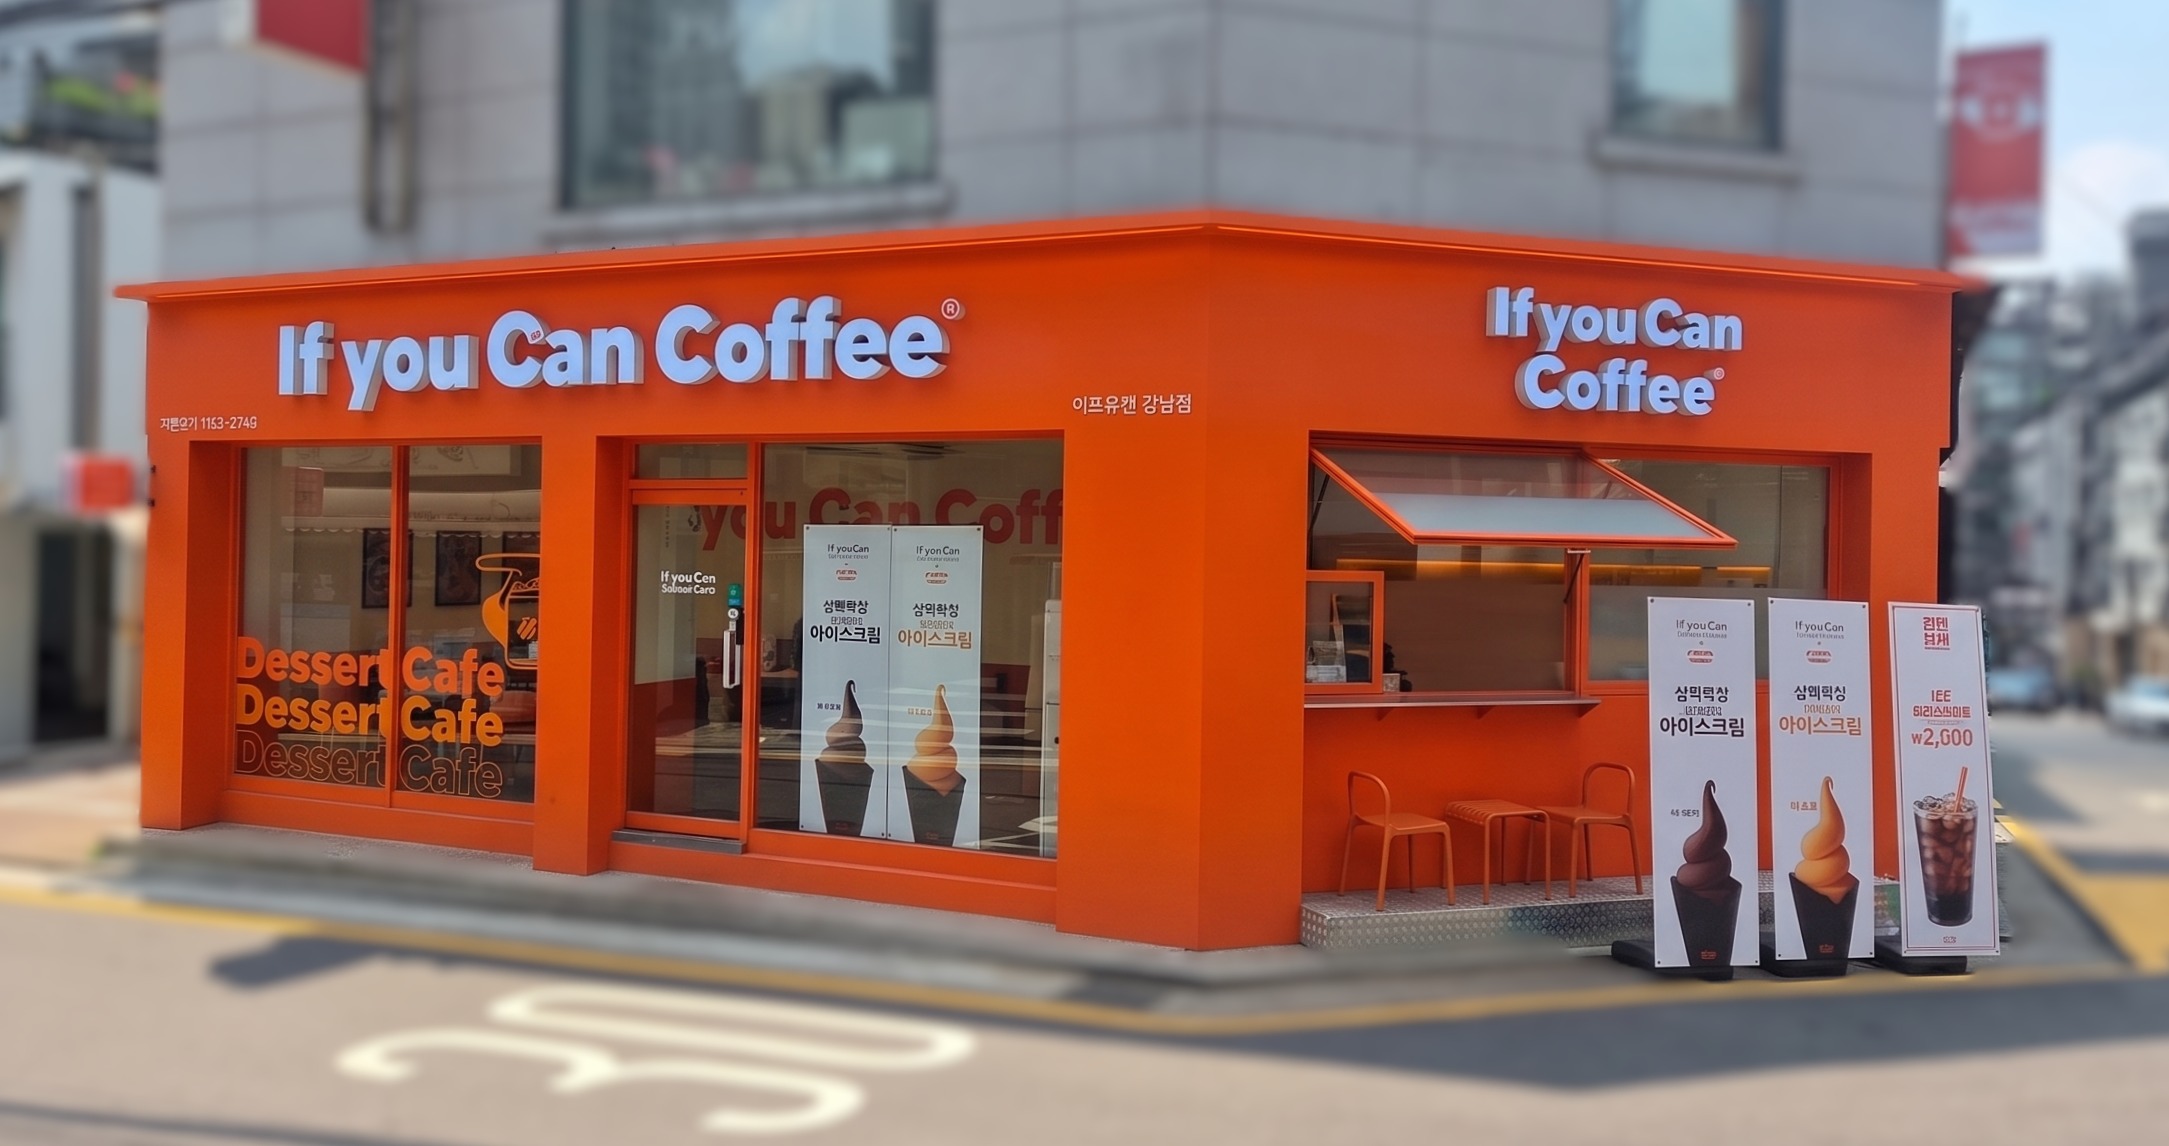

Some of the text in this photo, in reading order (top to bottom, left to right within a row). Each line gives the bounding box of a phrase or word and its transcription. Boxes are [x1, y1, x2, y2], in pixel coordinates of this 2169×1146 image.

[1486, 287, 1743, 352] If you Can
[279, 321, 334, 395] If
[341, 334, 479, 412] you
[487, 310, 644, 388] Can
[655, 295, 950, 385] Coffee
[1515, 354, 1716, 415] Coffee
[1072, 394, 1191, 415] 이프유캔 강남점
[660, 570, 671, 582] If
[671, 574, 693, 587] you
[810, 625, 881, 645] 아이스크림
[1686, 623, 1706, 632] you
[1707, 621, 1727, 632] Can
[1803, 624, 1823, 633] you
[898, 629, 973, 649] 아이스크림
[237, 636, 505, 697] Dessert Cafe
[235, 683, 504, 747] Dessert Cafe
[1779, 715, 1862, 736] 아이스크림
[1660, 716, 1745, 737] 아이스크림
[234, 729, 503, 798] Dessert Cafe
[334, 983, 977, 1136] 30
